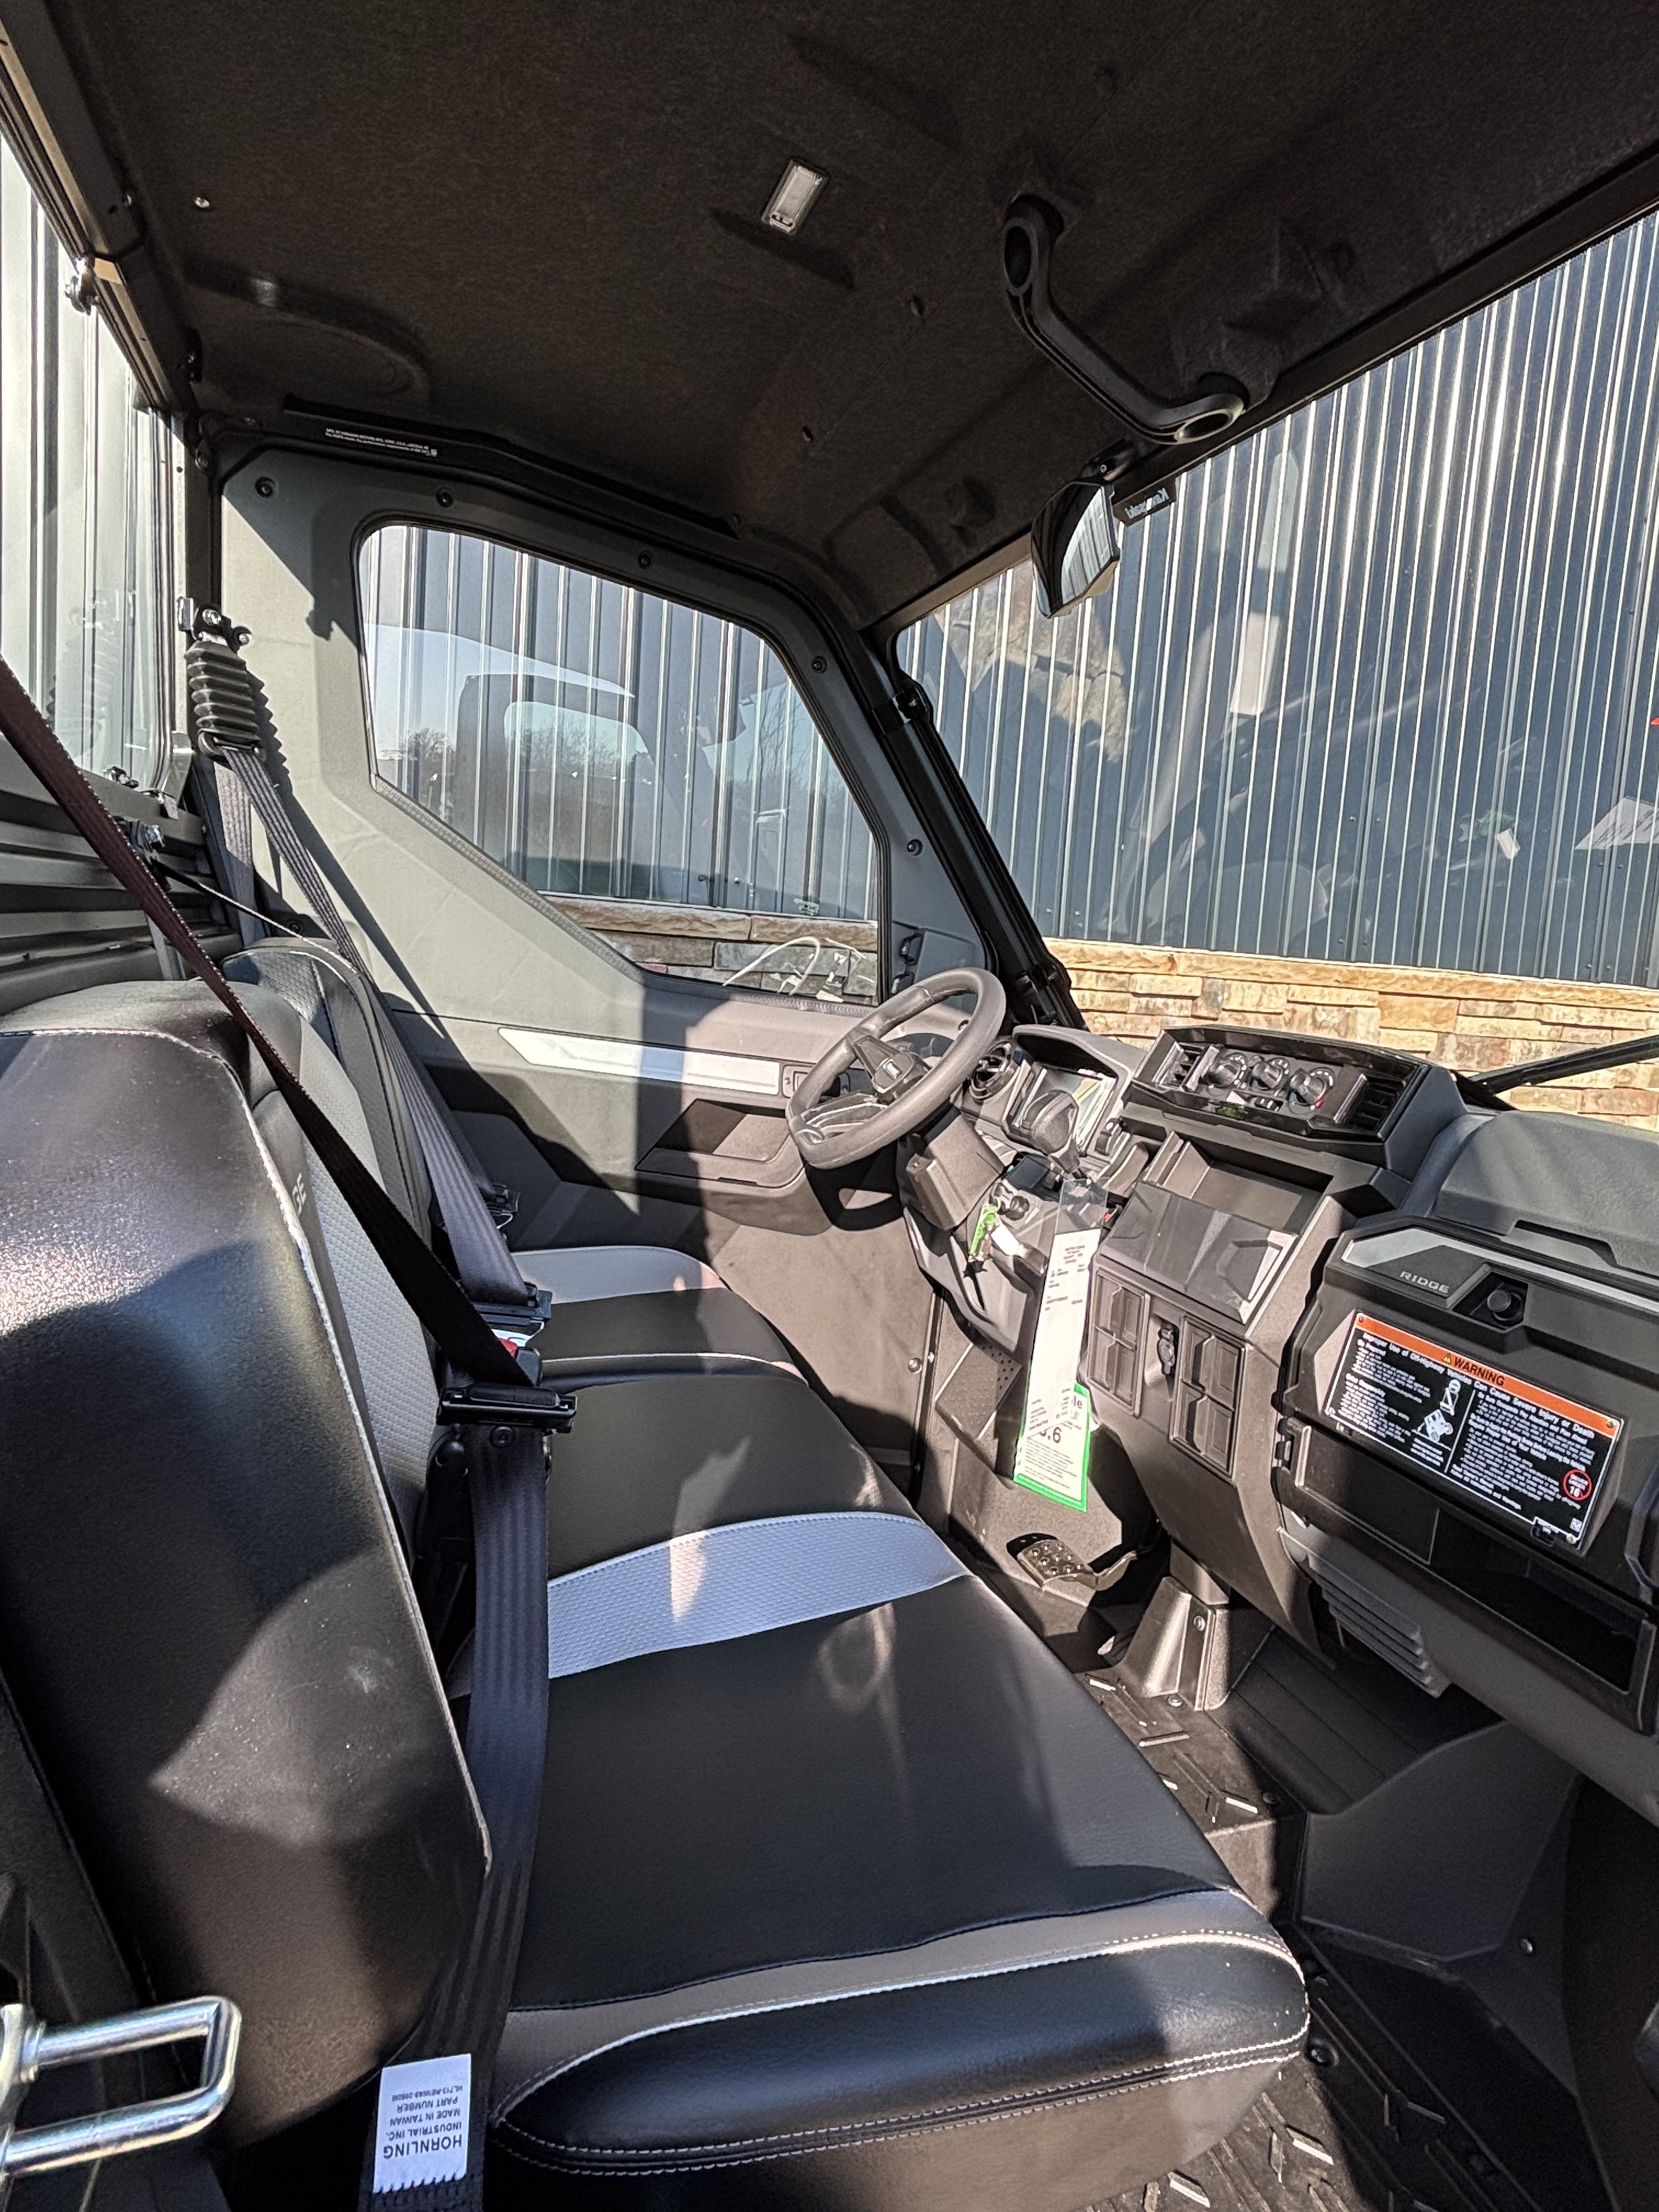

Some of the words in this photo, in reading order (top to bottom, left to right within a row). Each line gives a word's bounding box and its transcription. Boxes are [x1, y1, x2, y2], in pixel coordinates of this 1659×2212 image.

[1400, 1271, 1449, 1294] RIDGE
[1454, 1357, 1505, 1386] WARNING
[397, 2100, 433, 2113] NUMBER
[437, 2096, 458, 2107] PART
[390, 2114, 422, 2126] TAIWAN
[426, 2111, 434, 2121] IN
[437, 2108, 460, 2119] MADE
[386, 2128, 405, 2141] INC.
[408, 2122, 462, 2136] INDUSTRIAL
[383, 2134, 462, 2159] HORNLING
